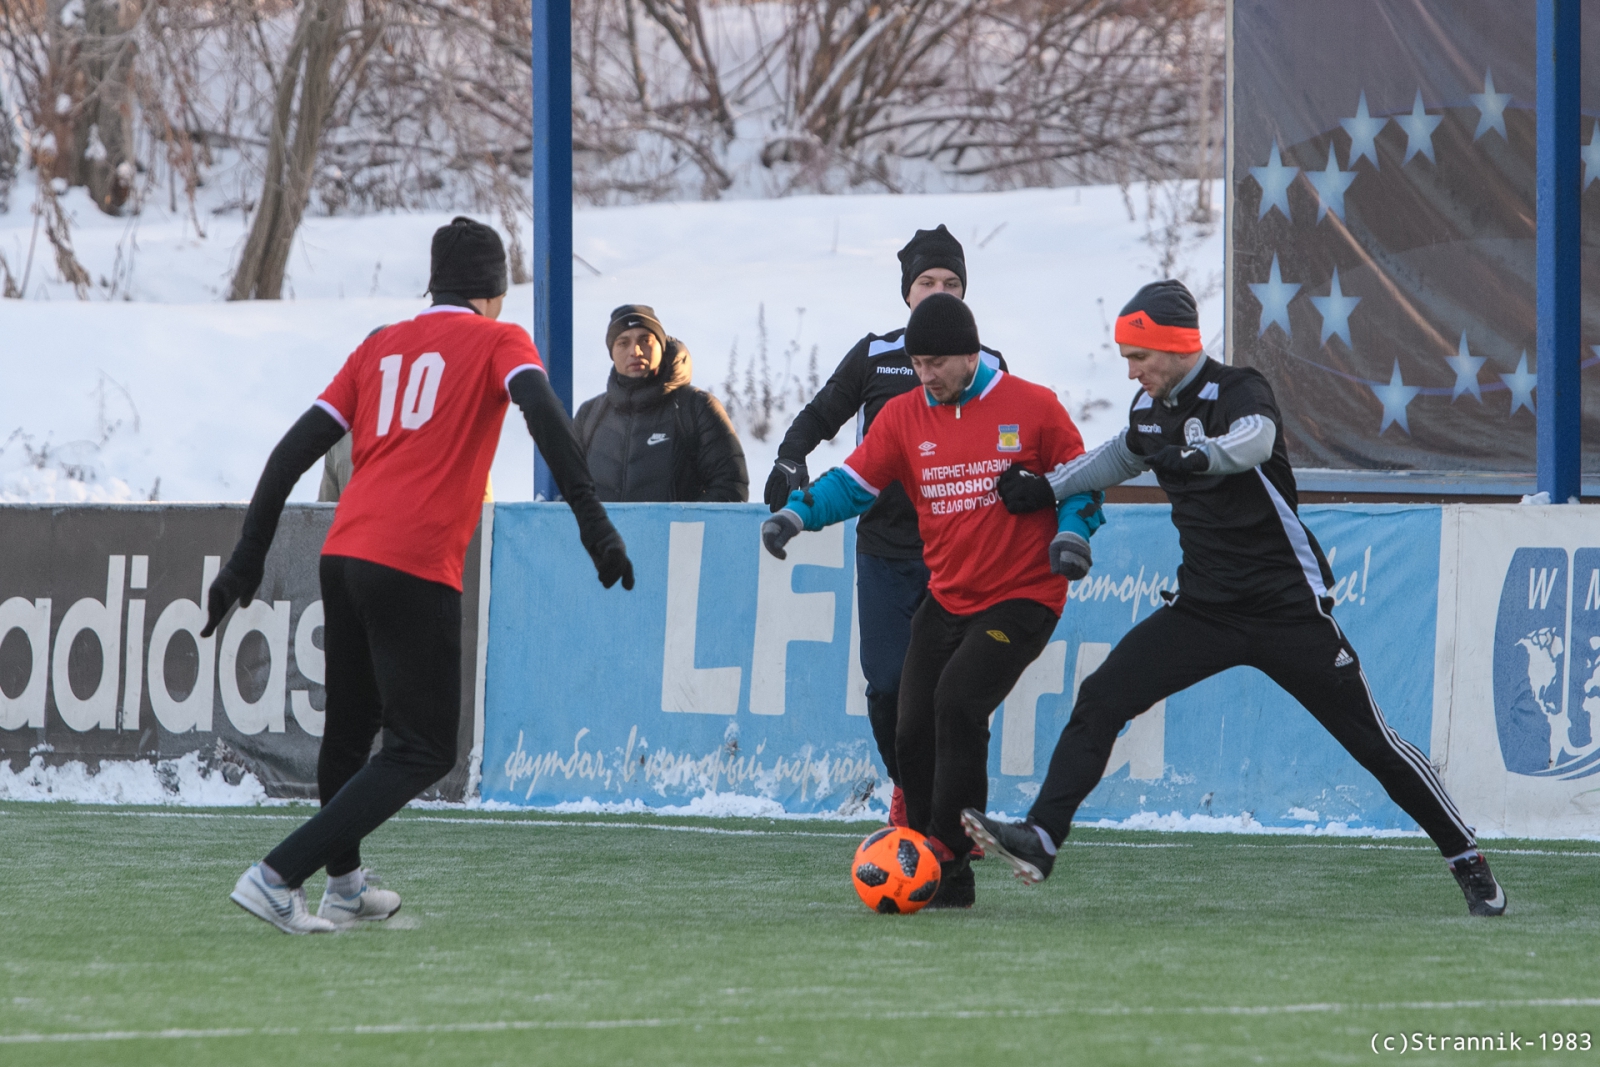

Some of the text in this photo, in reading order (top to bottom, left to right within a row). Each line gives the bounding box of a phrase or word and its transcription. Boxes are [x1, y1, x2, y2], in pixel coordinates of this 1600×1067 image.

[876, 366, 914, 376] macron
[376, 351, 446, 437] 10
[921, 458, 1012, 481] ИНТЕРНЕТ-МАГАЗИН
[946, 500, 963, 514] ДЛЯ
